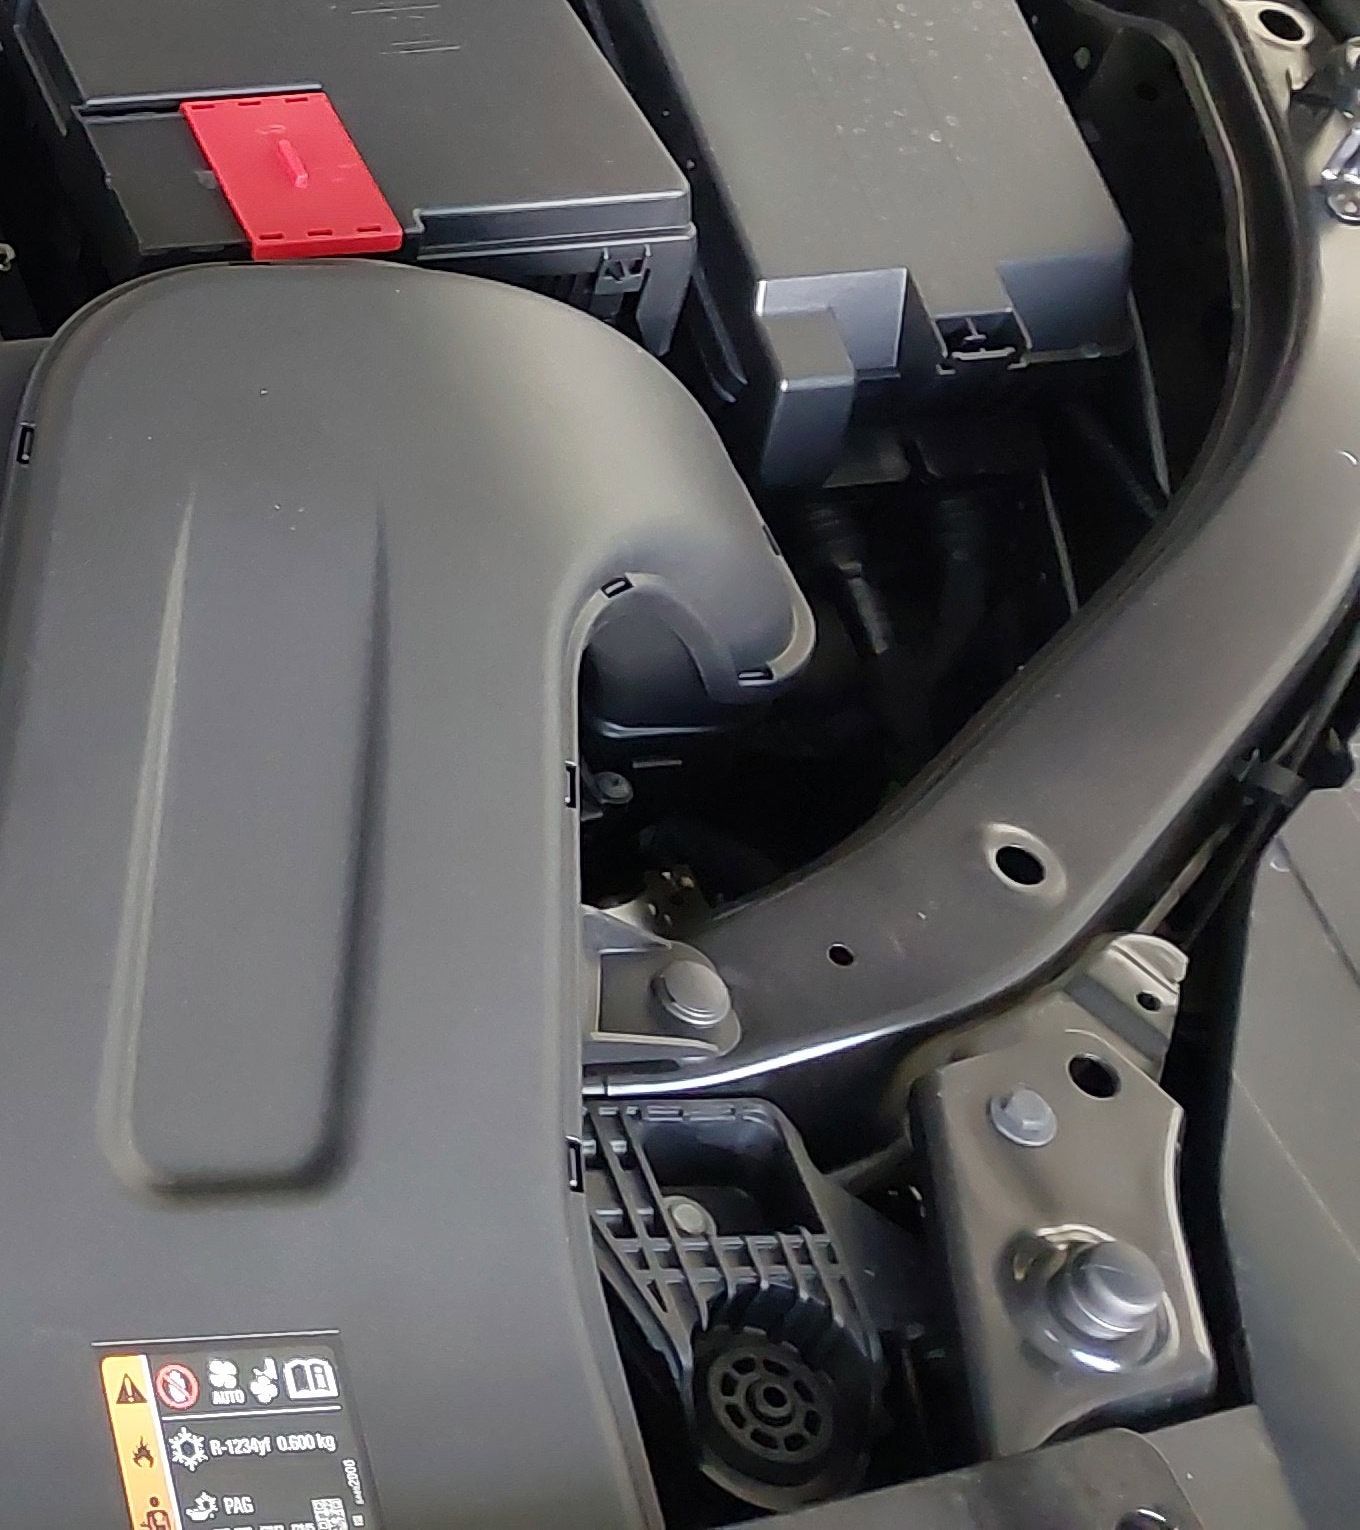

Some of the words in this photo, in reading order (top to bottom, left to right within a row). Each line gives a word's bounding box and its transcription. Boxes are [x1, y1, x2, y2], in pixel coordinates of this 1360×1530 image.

[212, 1390, 245, 1405] AUTO
[209, 1436, 272, 1456] R-1234yf
[317, 1434, 337, 1452] kg
[223, 1497, 254, 1514] PAG
